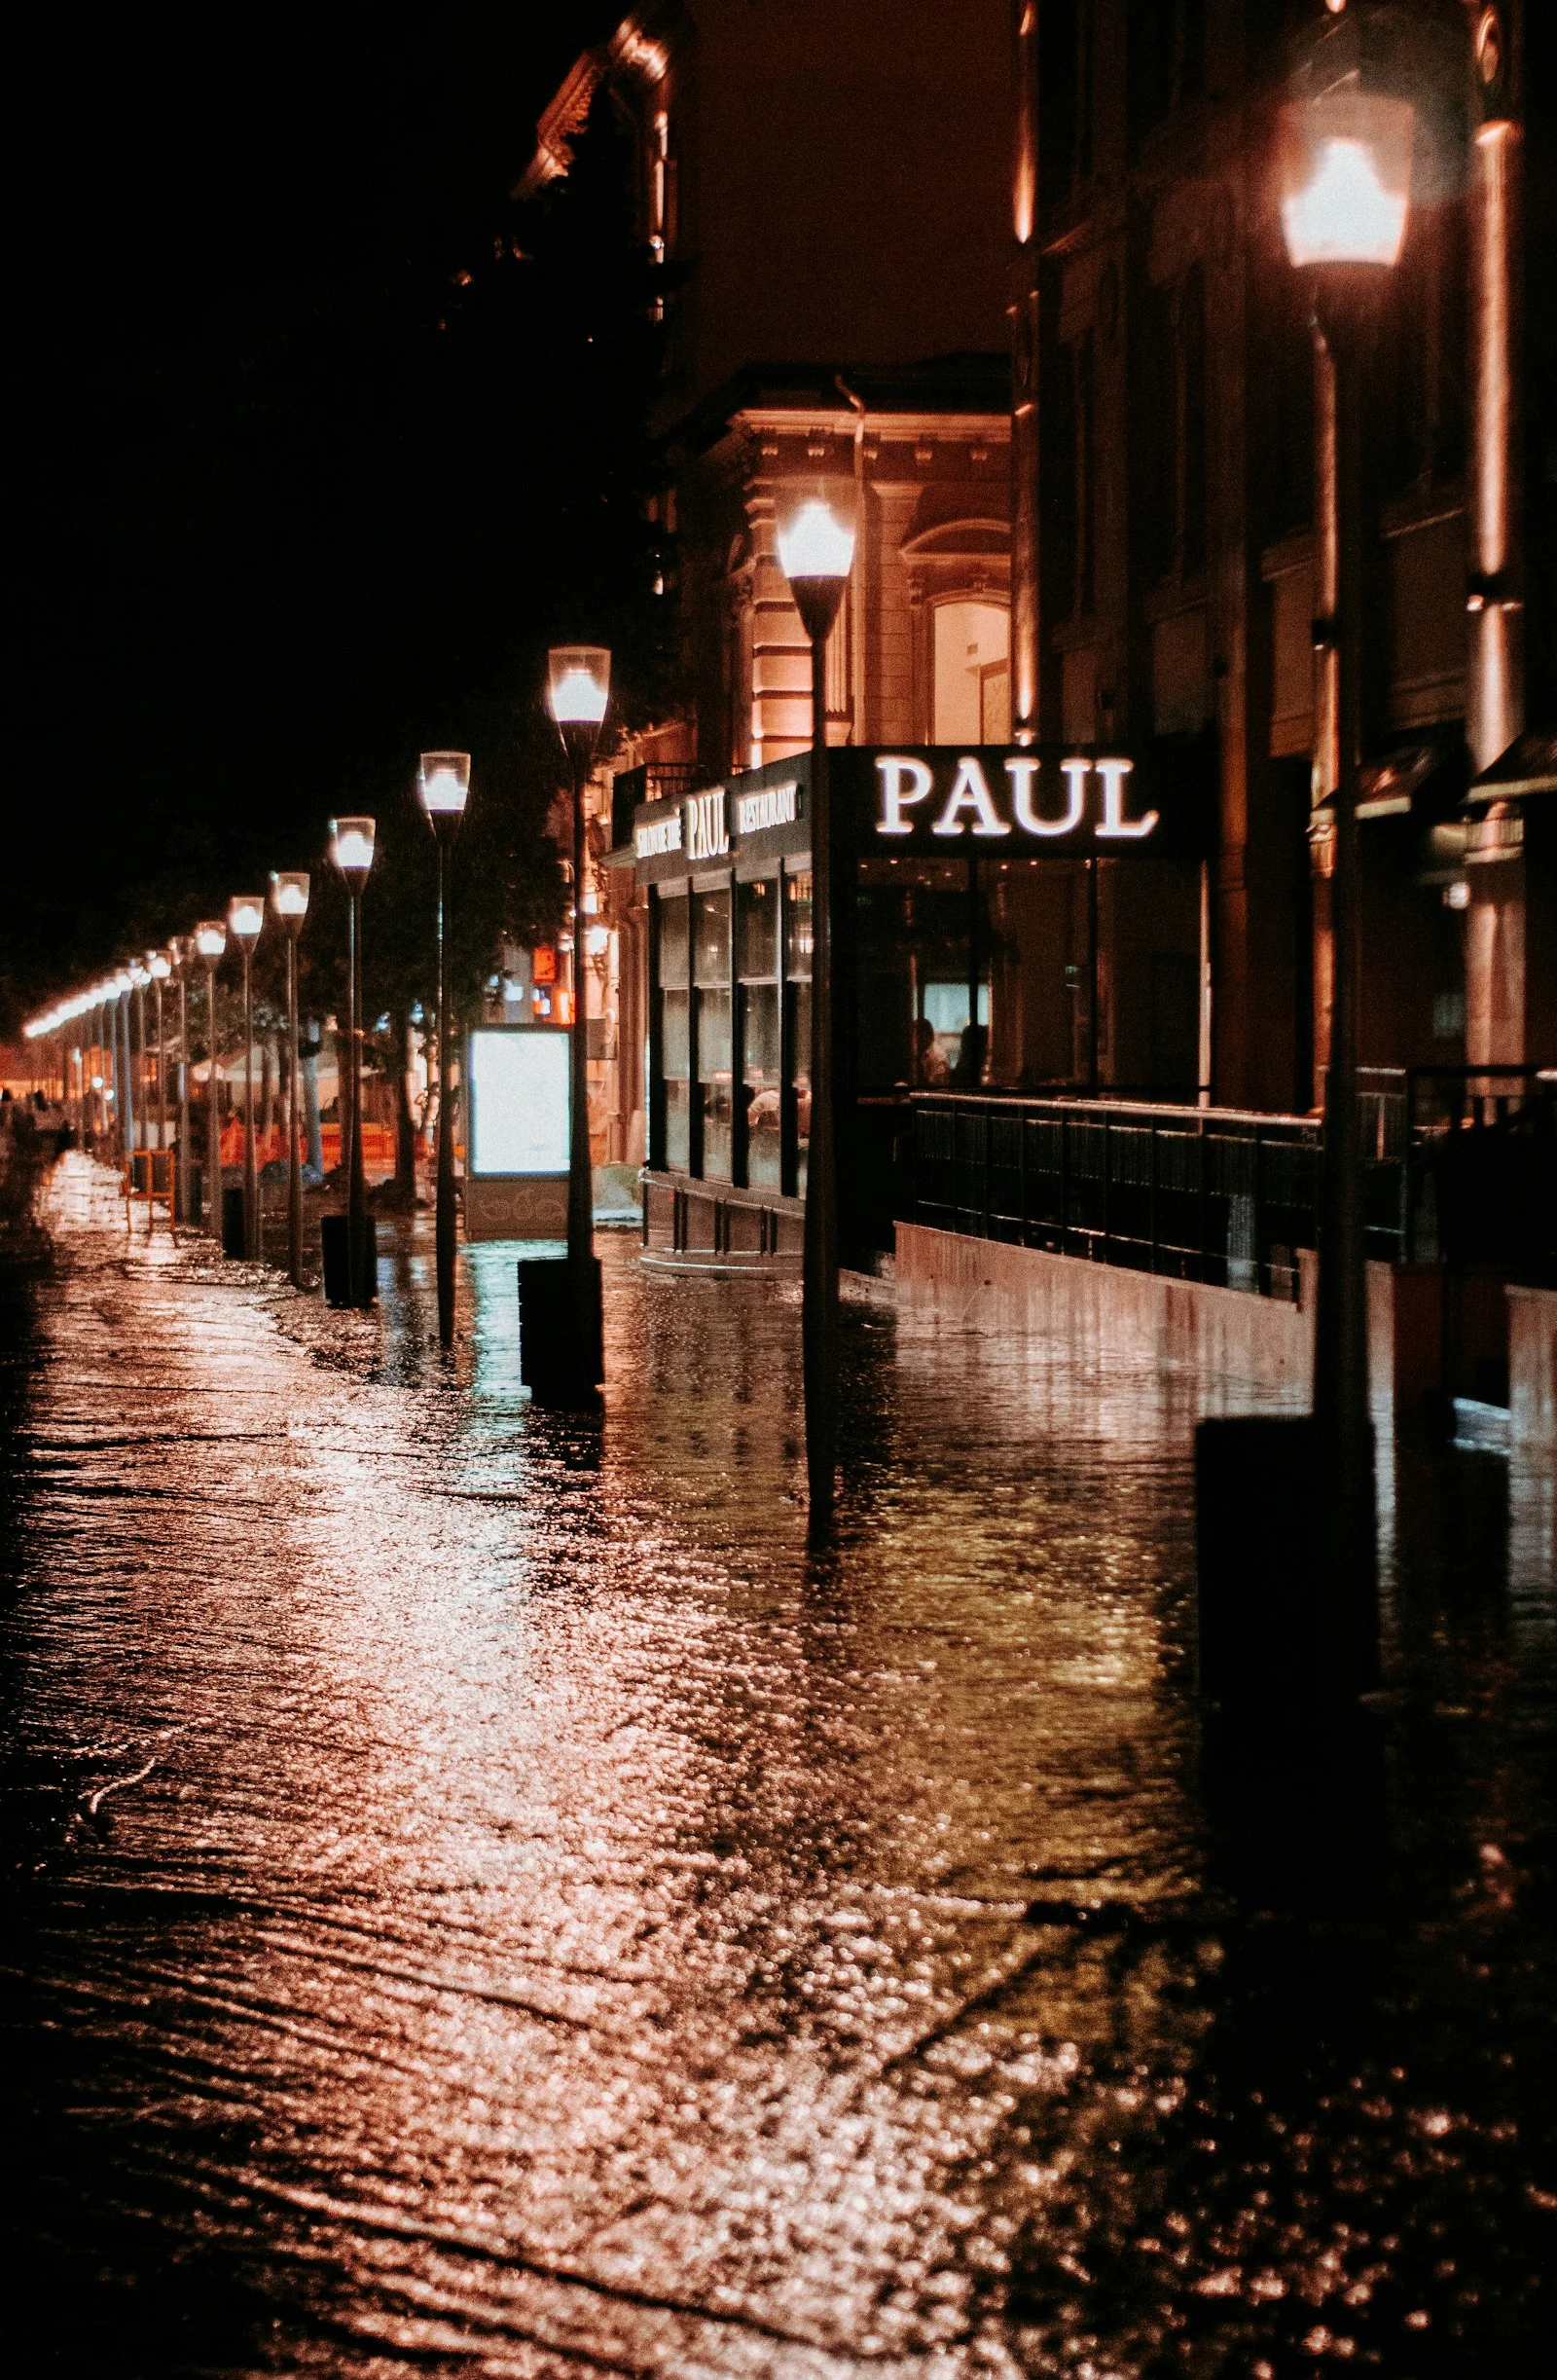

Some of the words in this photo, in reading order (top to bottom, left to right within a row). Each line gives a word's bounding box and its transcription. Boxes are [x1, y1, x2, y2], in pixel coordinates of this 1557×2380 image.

[687, 790, 729, 860] PAUL
[738, 783, 797, 834] RESTAURANT
[876, 755, 1159, 836] PAUL
